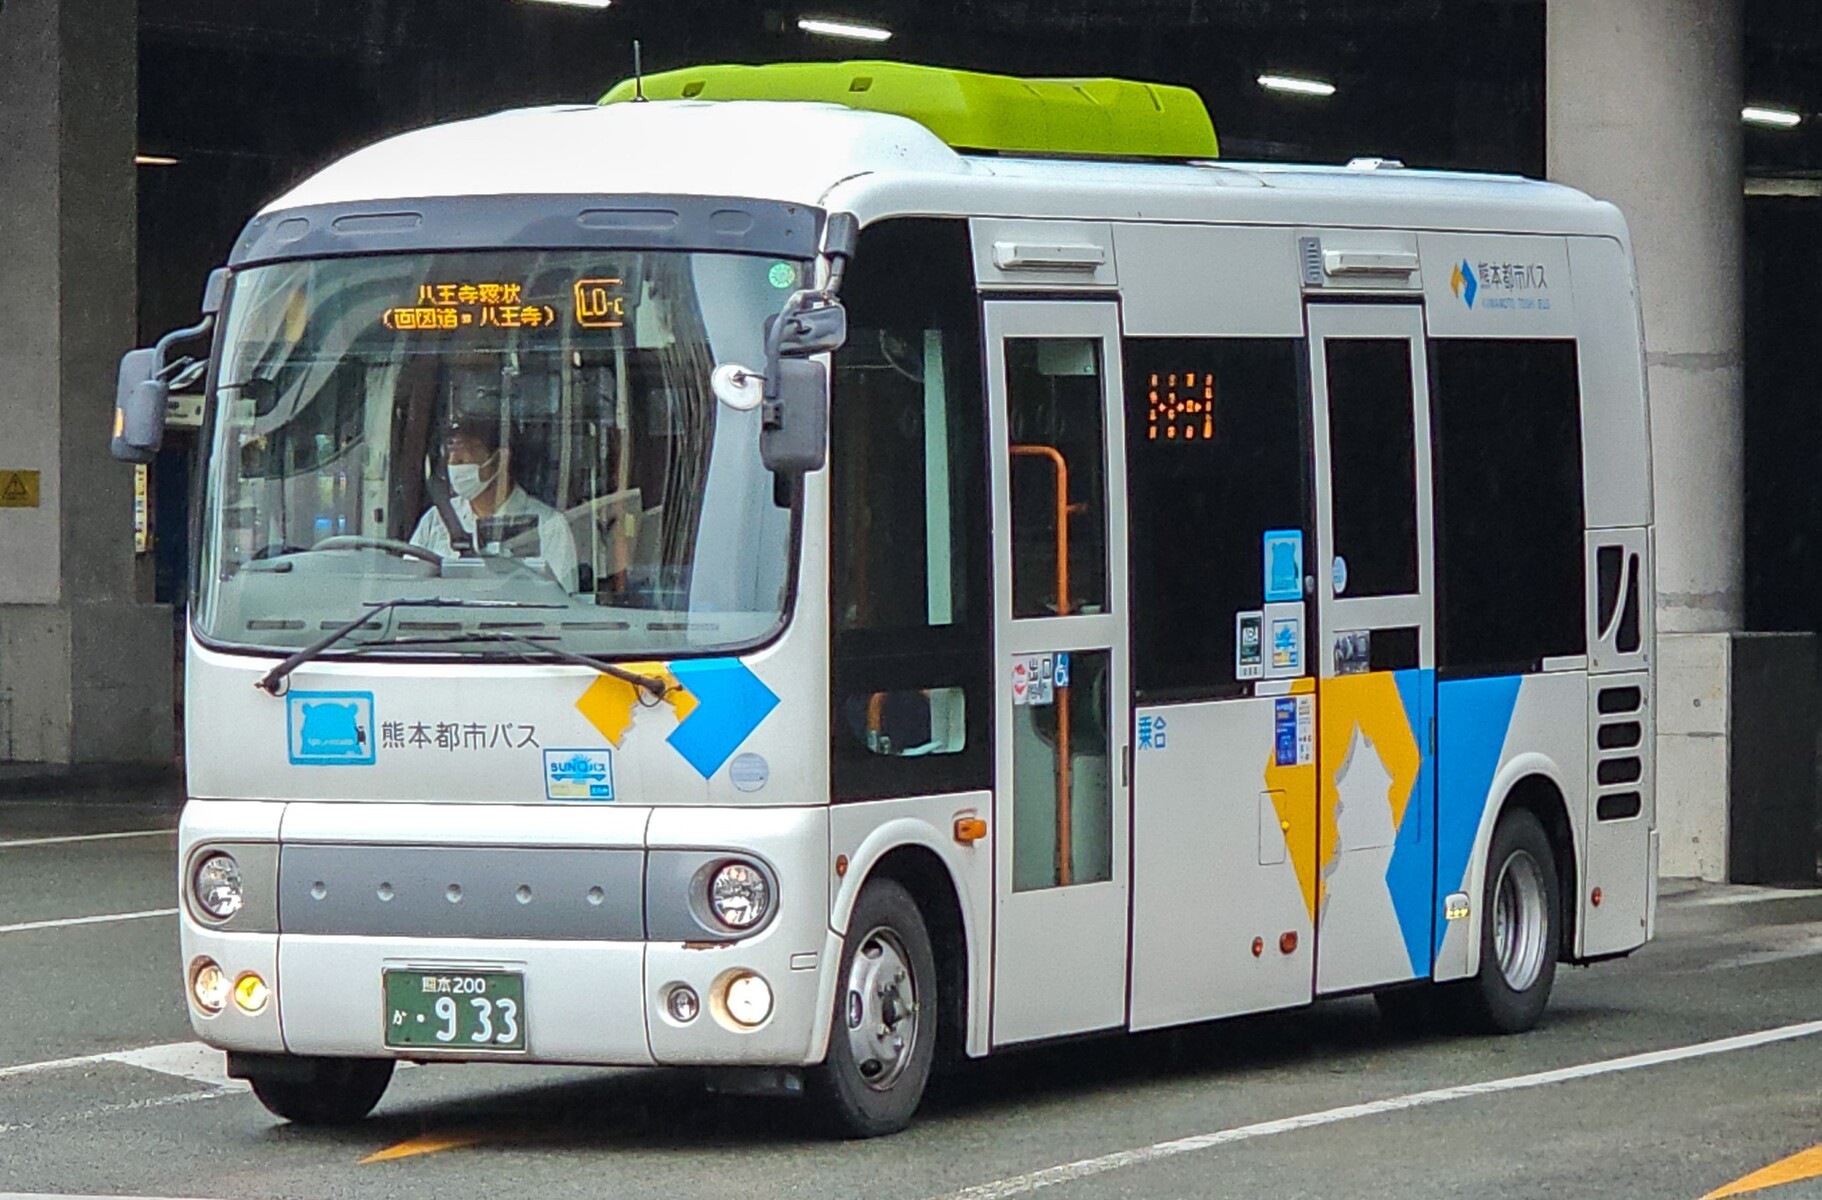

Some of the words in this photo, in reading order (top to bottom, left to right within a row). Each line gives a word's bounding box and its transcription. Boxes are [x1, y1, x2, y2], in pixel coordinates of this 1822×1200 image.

[381, 721, 540, 751] 熊本都市バス
